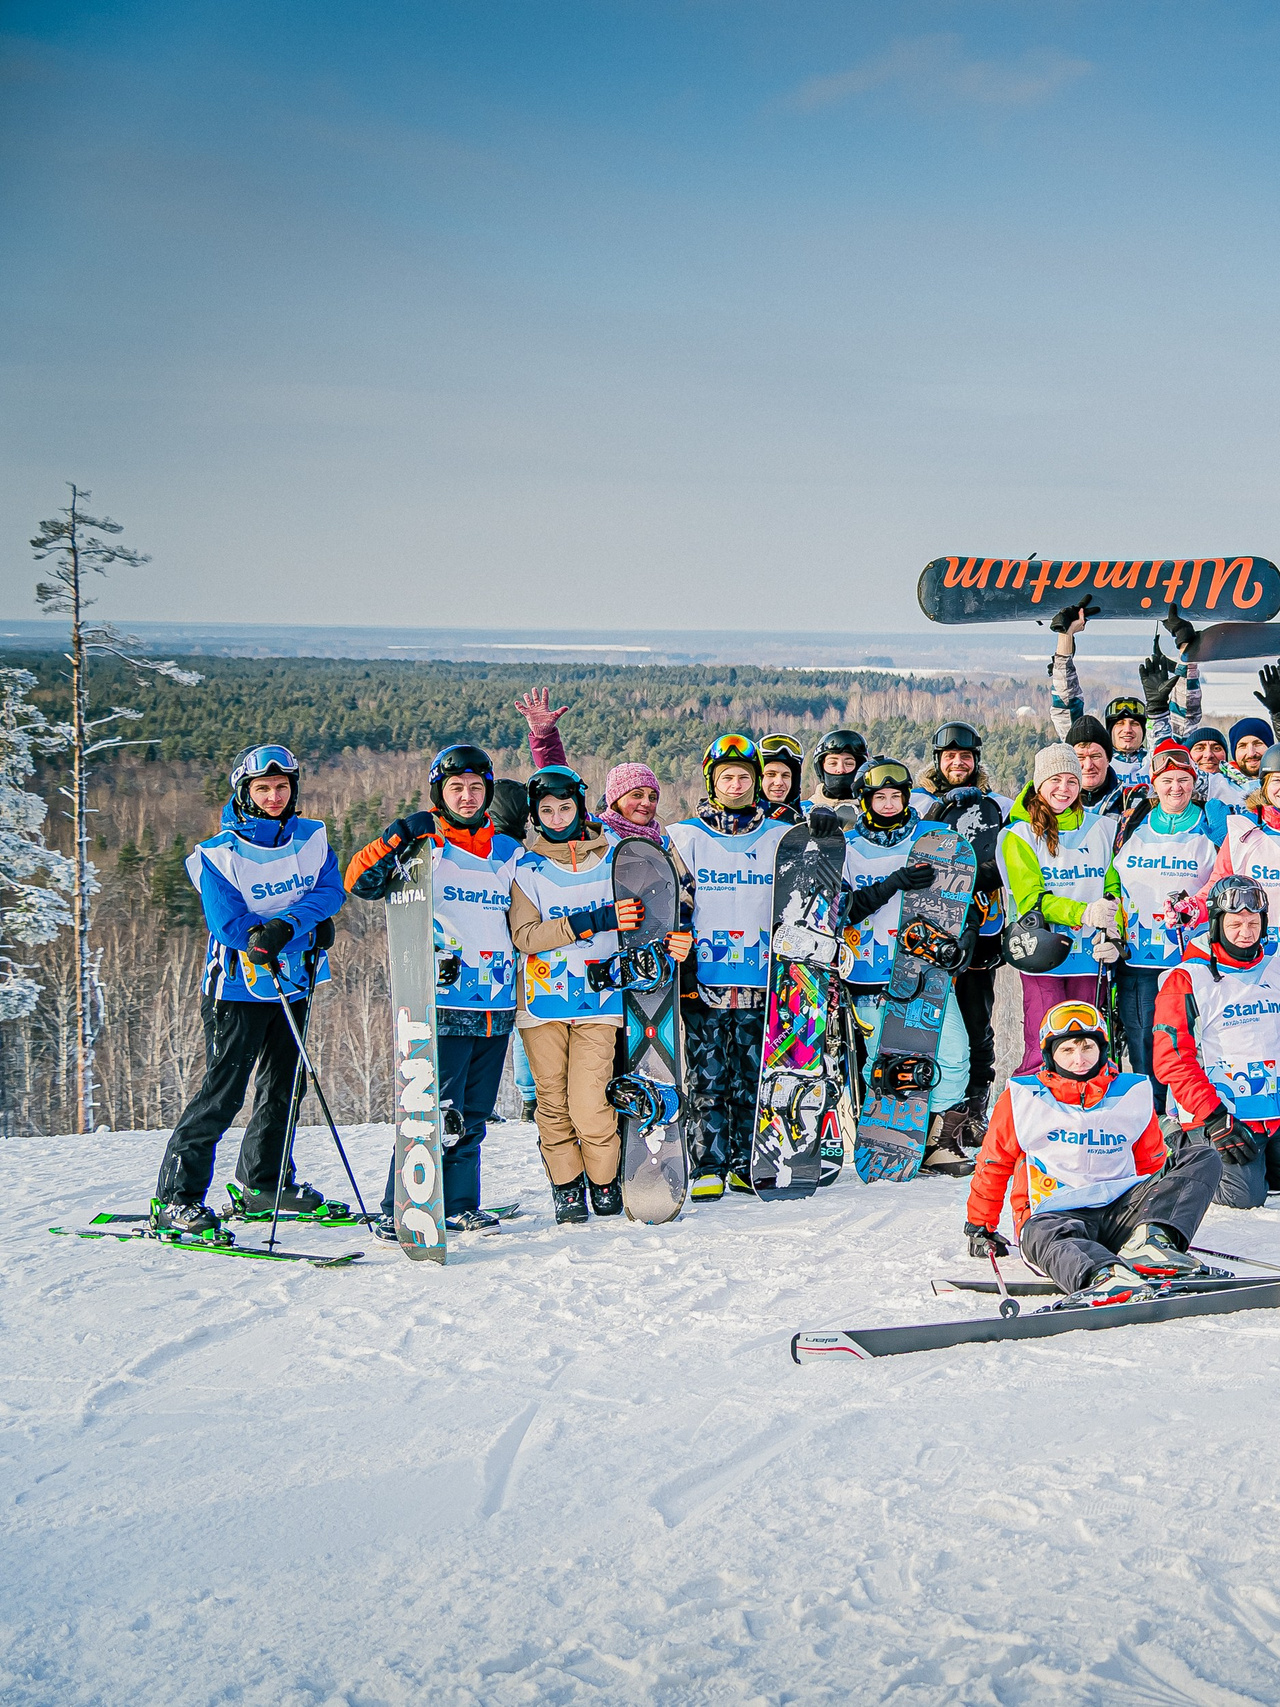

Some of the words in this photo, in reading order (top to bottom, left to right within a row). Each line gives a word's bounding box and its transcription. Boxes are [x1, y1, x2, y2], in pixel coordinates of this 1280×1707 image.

[944, 556, 1263, 610] Ultimatum
[1040, 864, 1105, 880] StarLine
[1126, 855, 1199, 871] StarLine
[697, 868, 774, 885] StarLine
[390, 888, 426, 905] RENTAL
[1008, 932, 1038, 961] 45
[768, 1025, 794, 1051] TRANS
[397, 1008, 439, 1248] JOINT
[1046, 1128, 1128, 1146] StarLine
